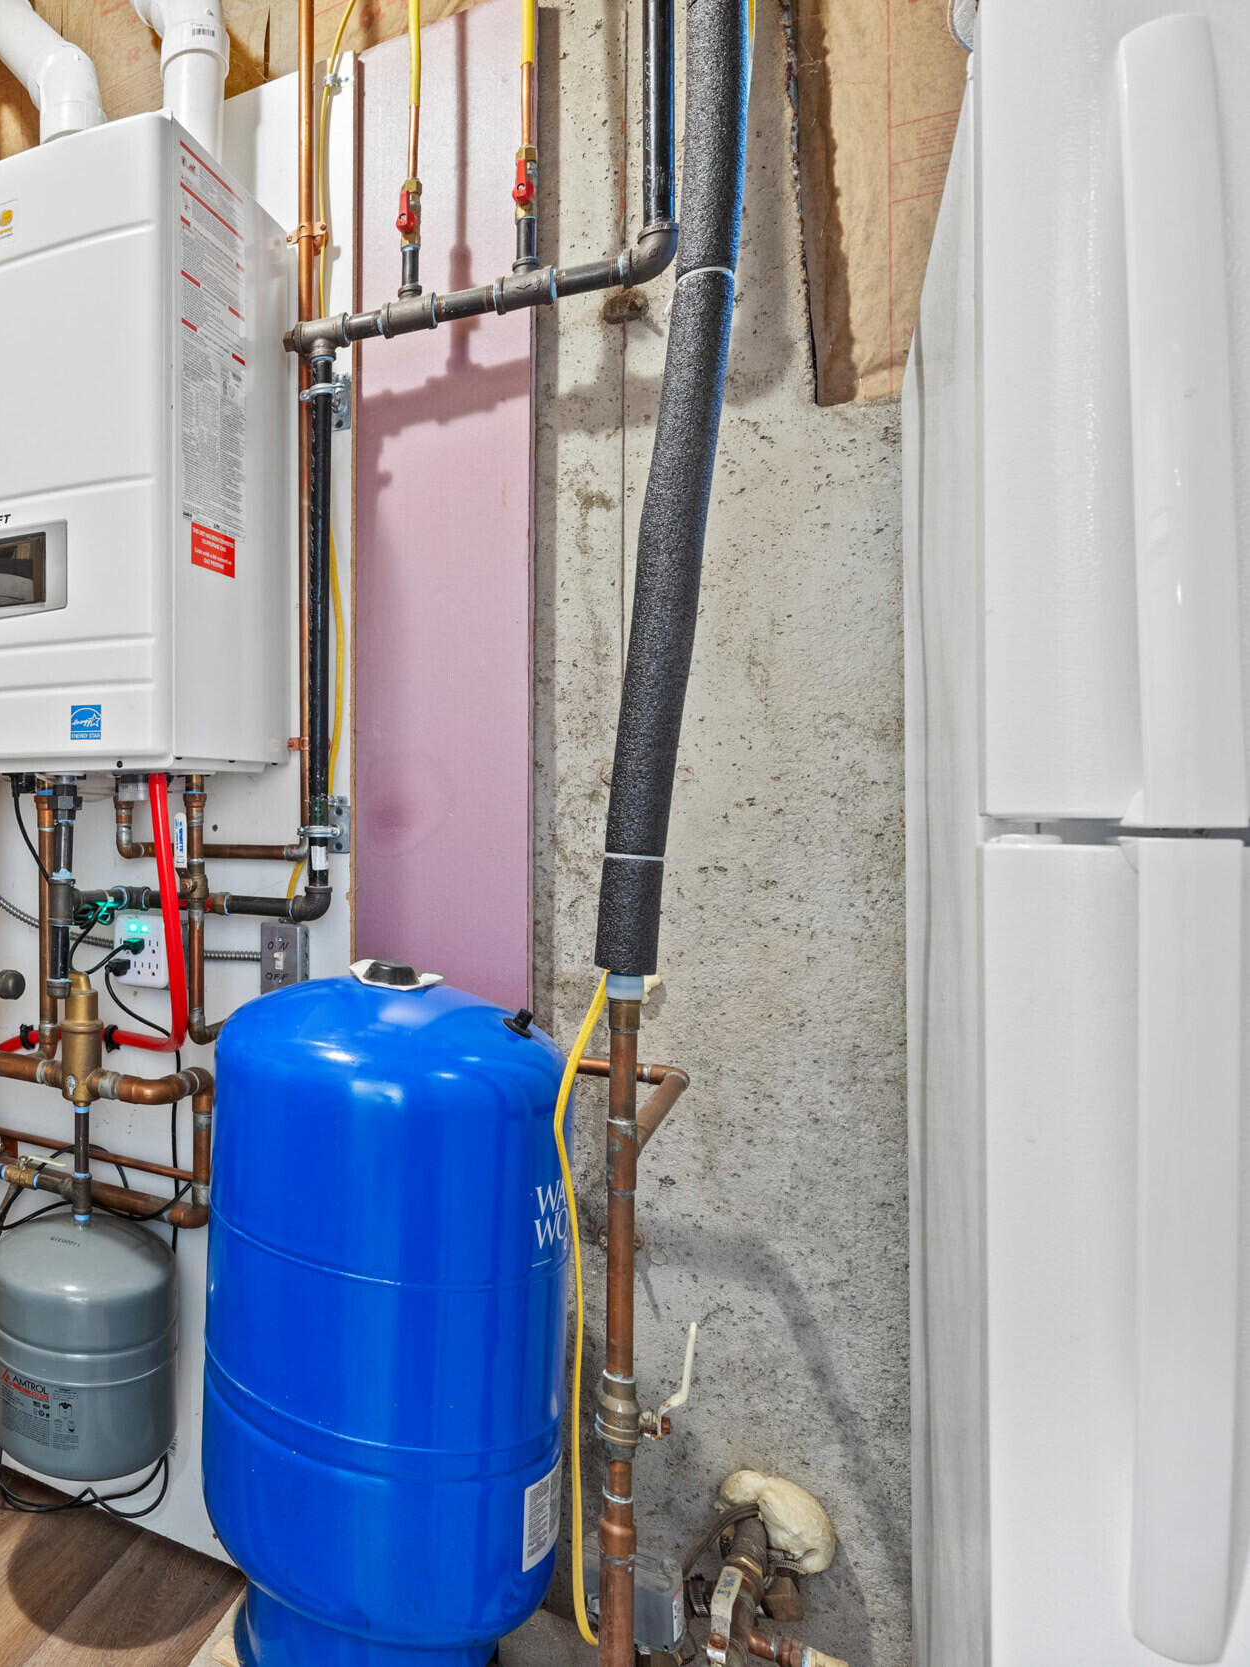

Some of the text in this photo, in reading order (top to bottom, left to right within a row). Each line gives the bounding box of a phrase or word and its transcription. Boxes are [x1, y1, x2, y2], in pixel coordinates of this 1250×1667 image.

[267, 941, 289, 951] ON
[265, 971, 288, 981] OFF
[12, 1375, 49, 1395] AMTROL
